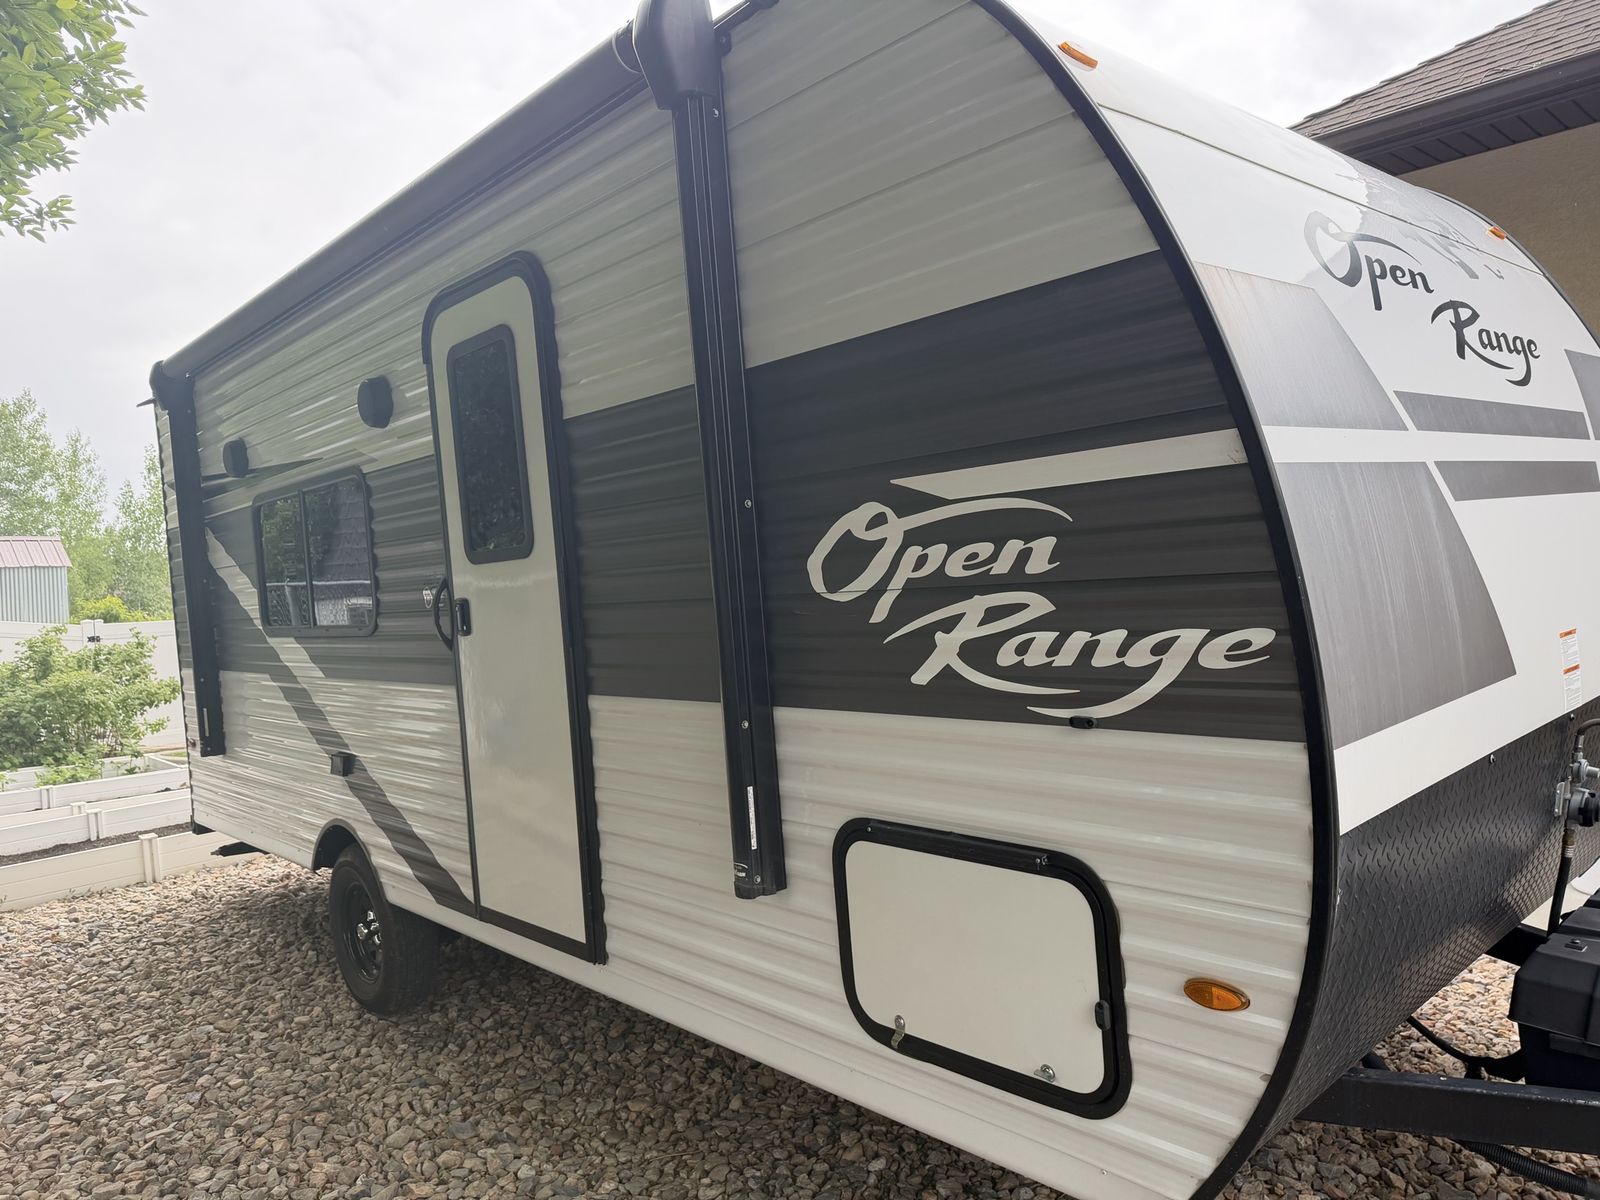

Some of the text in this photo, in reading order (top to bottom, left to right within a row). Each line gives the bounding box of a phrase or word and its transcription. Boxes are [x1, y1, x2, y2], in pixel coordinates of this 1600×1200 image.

[1304, 211, 1434, 311] Open
[1431, 300, 1540, 387] Range
[807, 498, 1073, 624] Open
[883, 591, 1276, 719] Range
